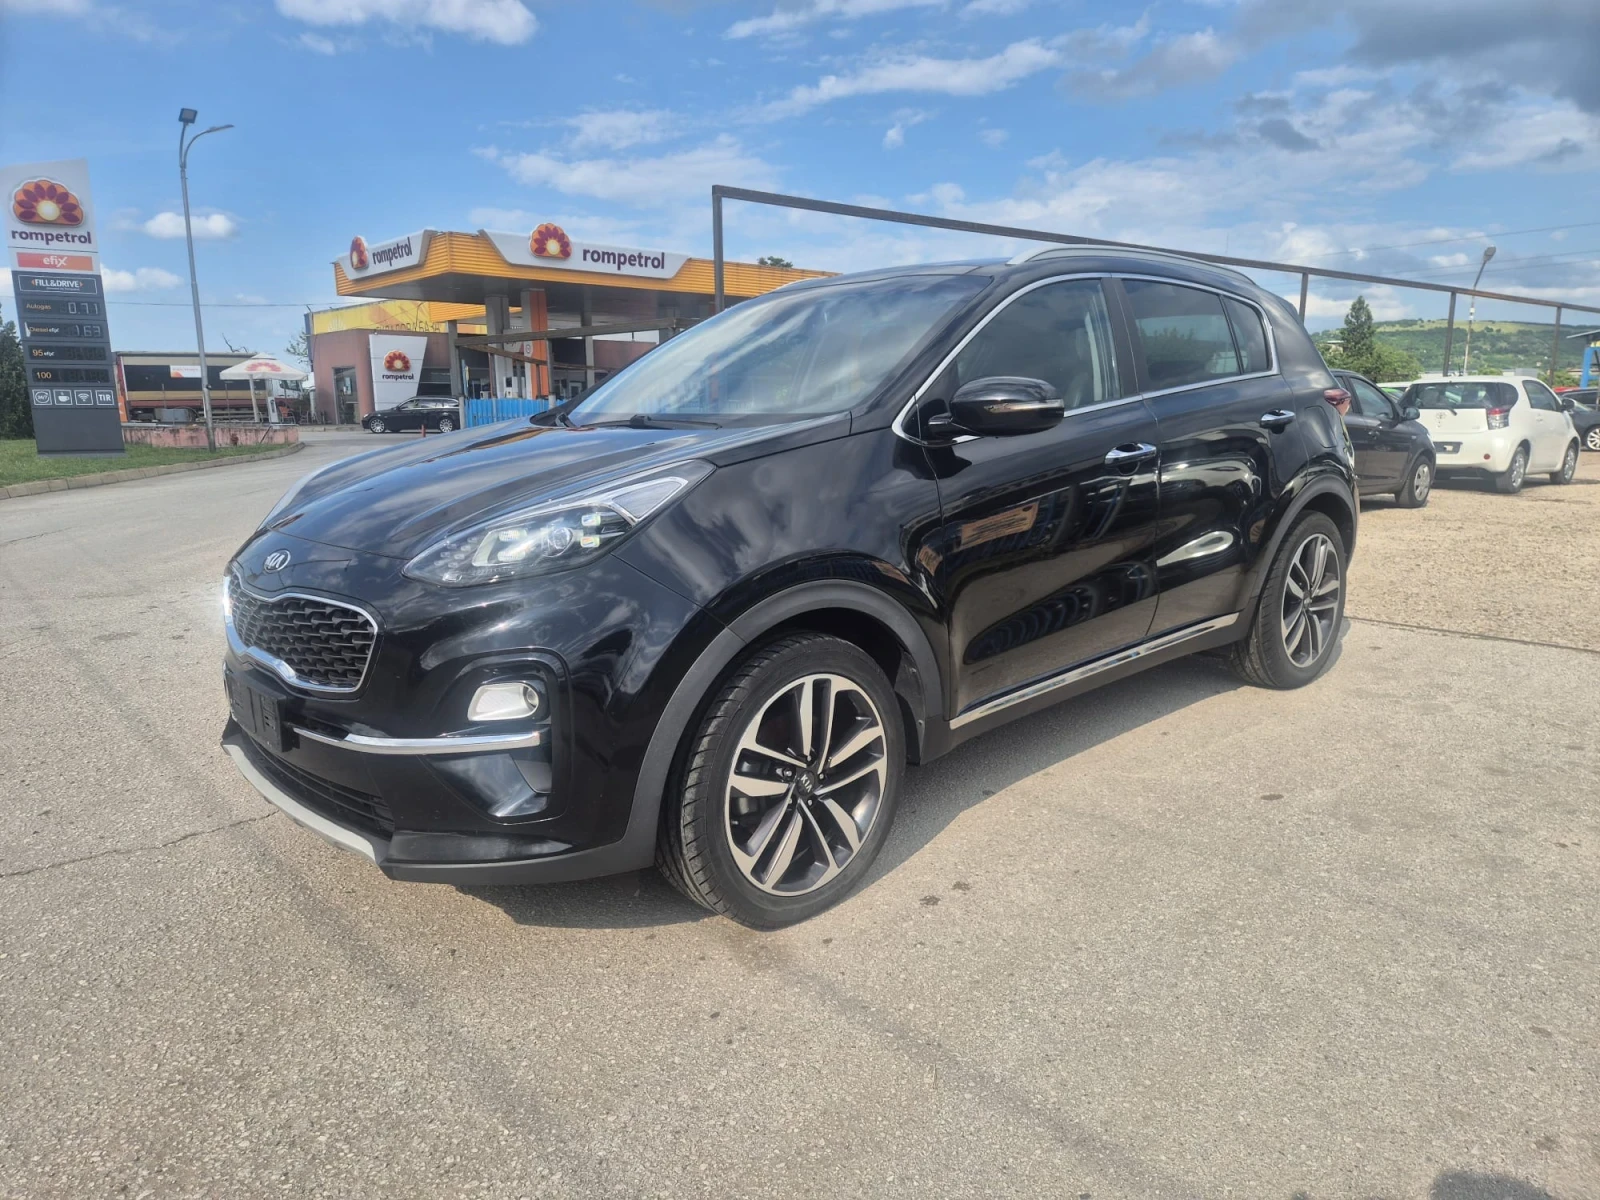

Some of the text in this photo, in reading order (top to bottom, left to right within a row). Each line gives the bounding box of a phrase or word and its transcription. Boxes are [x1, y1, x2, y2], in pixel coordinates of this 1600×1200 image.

[11, 230, 92, 245] rompetrol
[372, 236, 412, 267] rompetrol
[43, 256, 68, 267] efix
[582, 248, 665, 270] rompetrol
[32, 349, 44, 357] 95
[37, 371, 52, 379] 100
[382, 373, 415, 381] rompetrol
[98, 394, 112, 402] TIR
